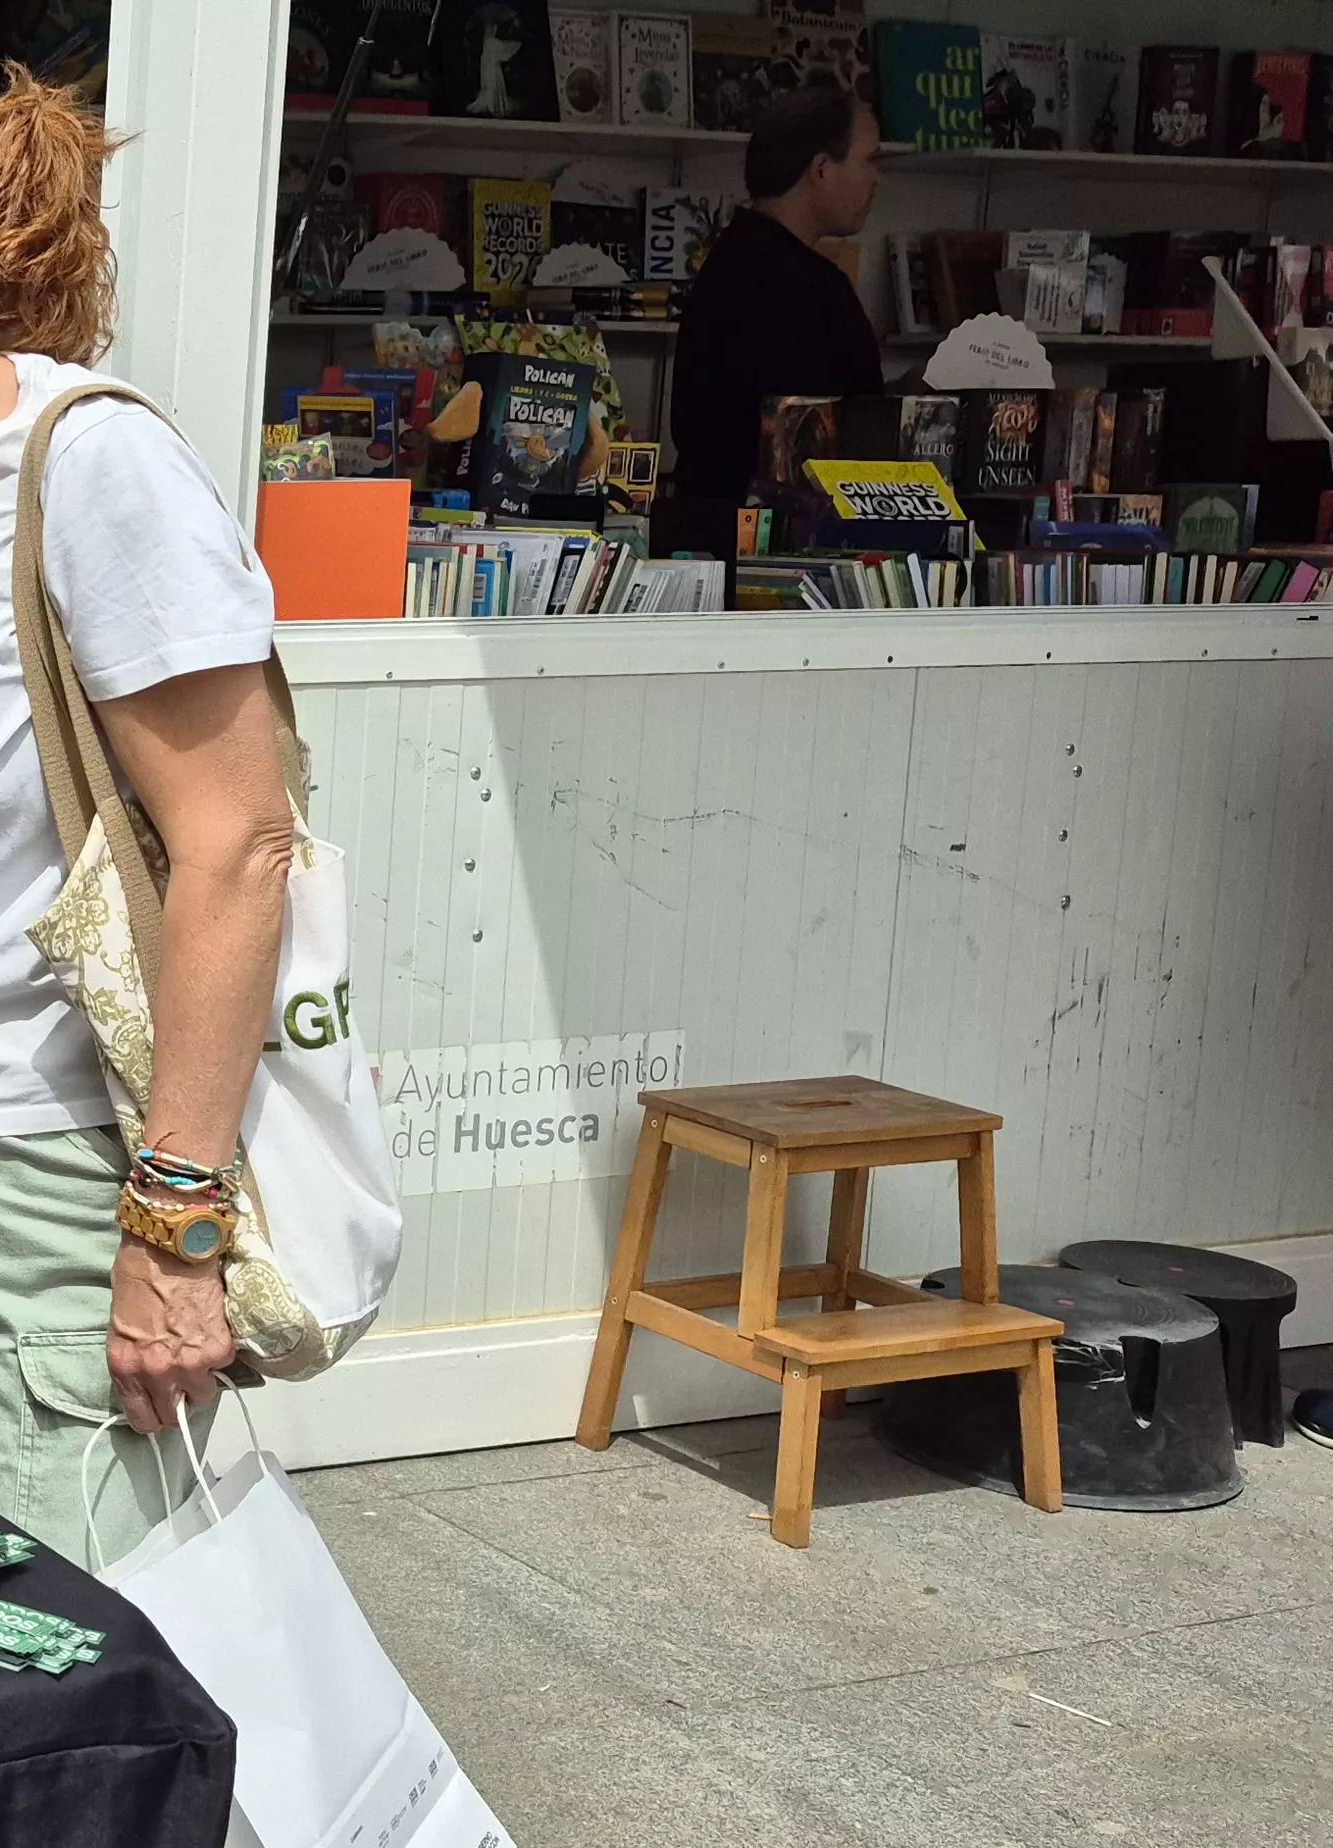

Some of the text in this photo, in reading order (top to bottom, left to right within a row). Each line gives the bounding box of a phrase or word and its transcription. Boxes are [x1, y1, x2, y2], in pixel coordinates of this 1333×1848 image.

[946, 46, 979, 71] ar
[916, 72, 972, 109] qui
[939, 100, 982, 131] tec
[485, 218, 545, 238] WORLD
[484, 236, 545, 252] RECORDS
[524, 364, 576, 388] POLICÁN
[986, 441, 1032, 462] SIGHT
[979, 465, 1036, 488] UNSEEN
[836, 480, 939, 497] GUINNESS
[848, 495, 951, 517] WORLD
[394, 1048, 668, 1112] Ayuntamiento
[392, 1112, 599, 1159] de Huesca
